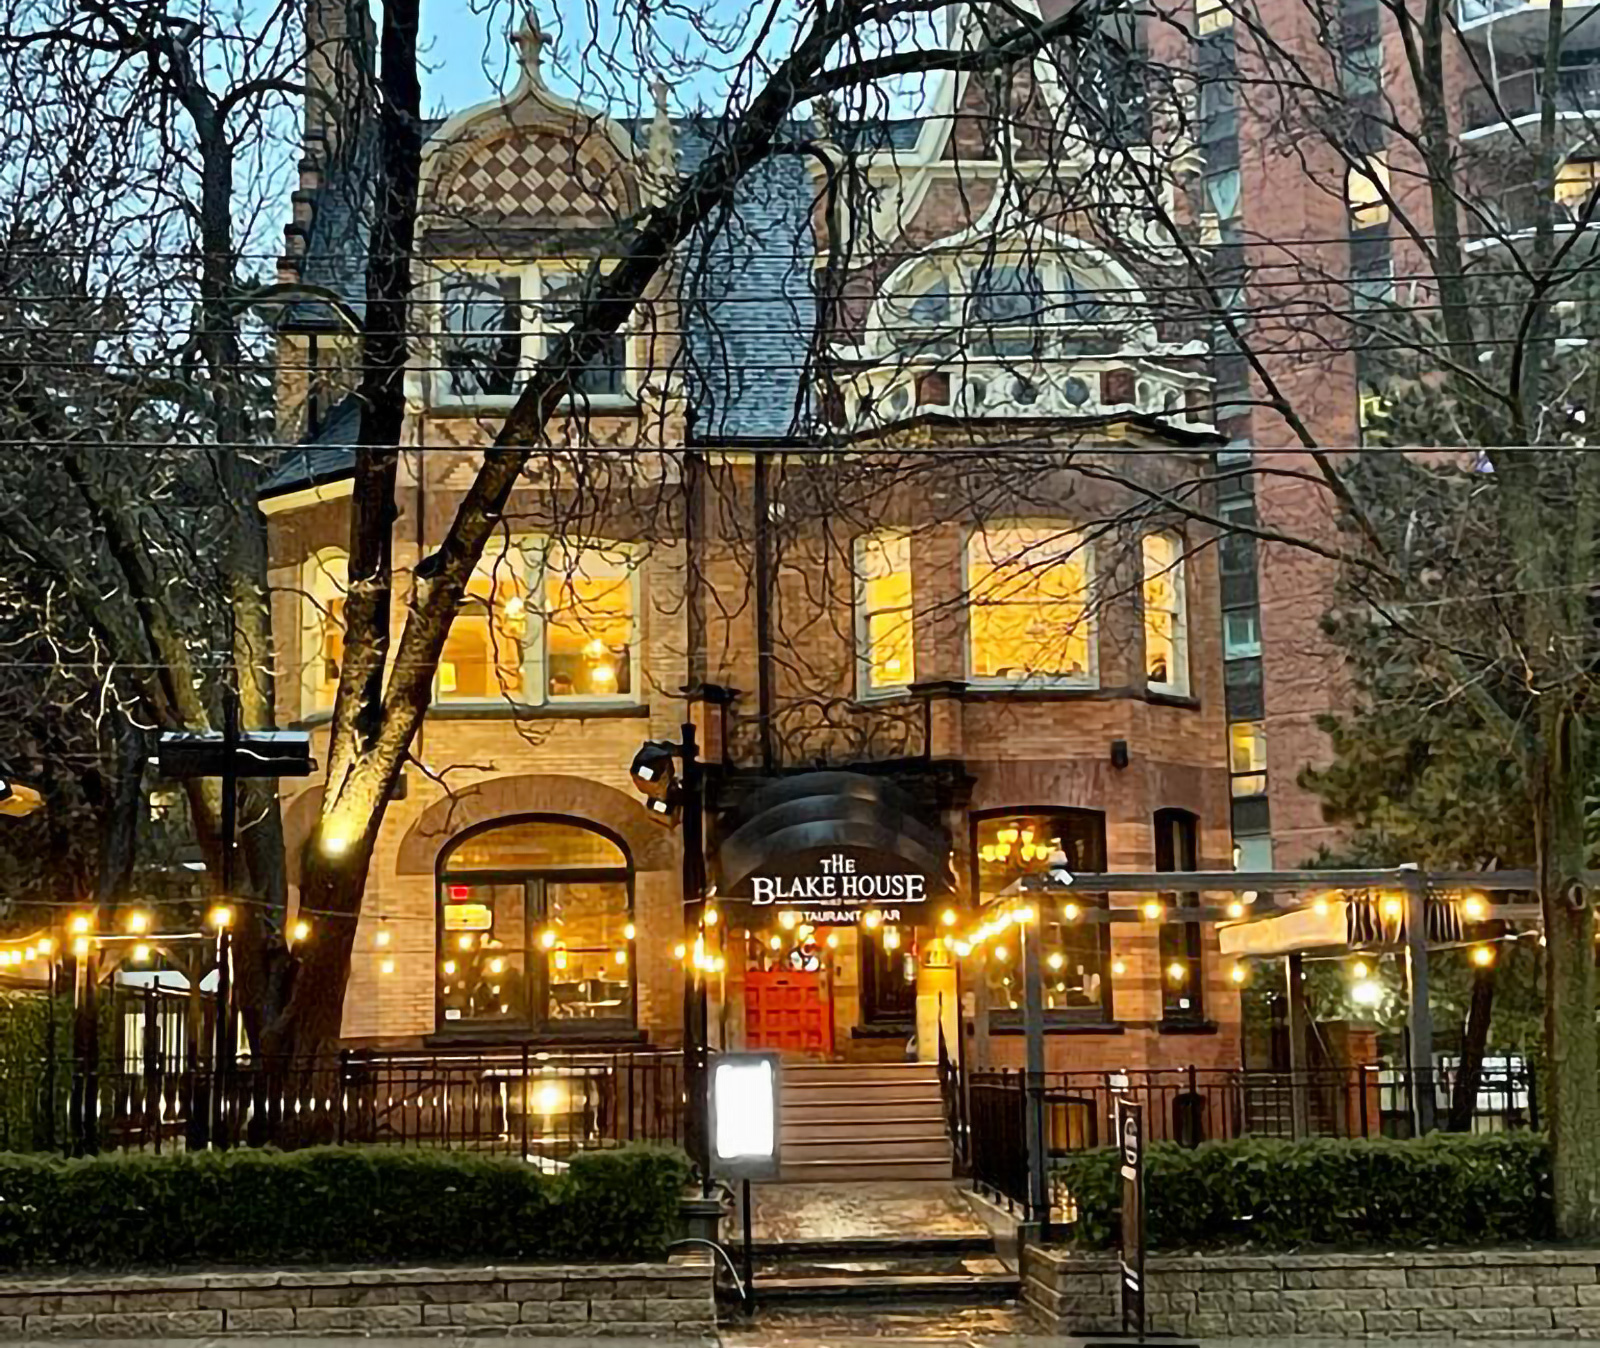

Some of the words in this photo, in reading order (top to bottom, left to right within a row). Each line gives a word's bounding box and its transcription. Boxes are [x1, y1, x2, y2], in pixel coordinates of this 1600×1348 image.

[820, 854, 856, 874] THE
[751, 876, 836, 905] BLAKE
[842, 875, 927, 902] HOUSE
[778, 910, 861, 921] TAURANT
[873, 909, 900, 921] AR
